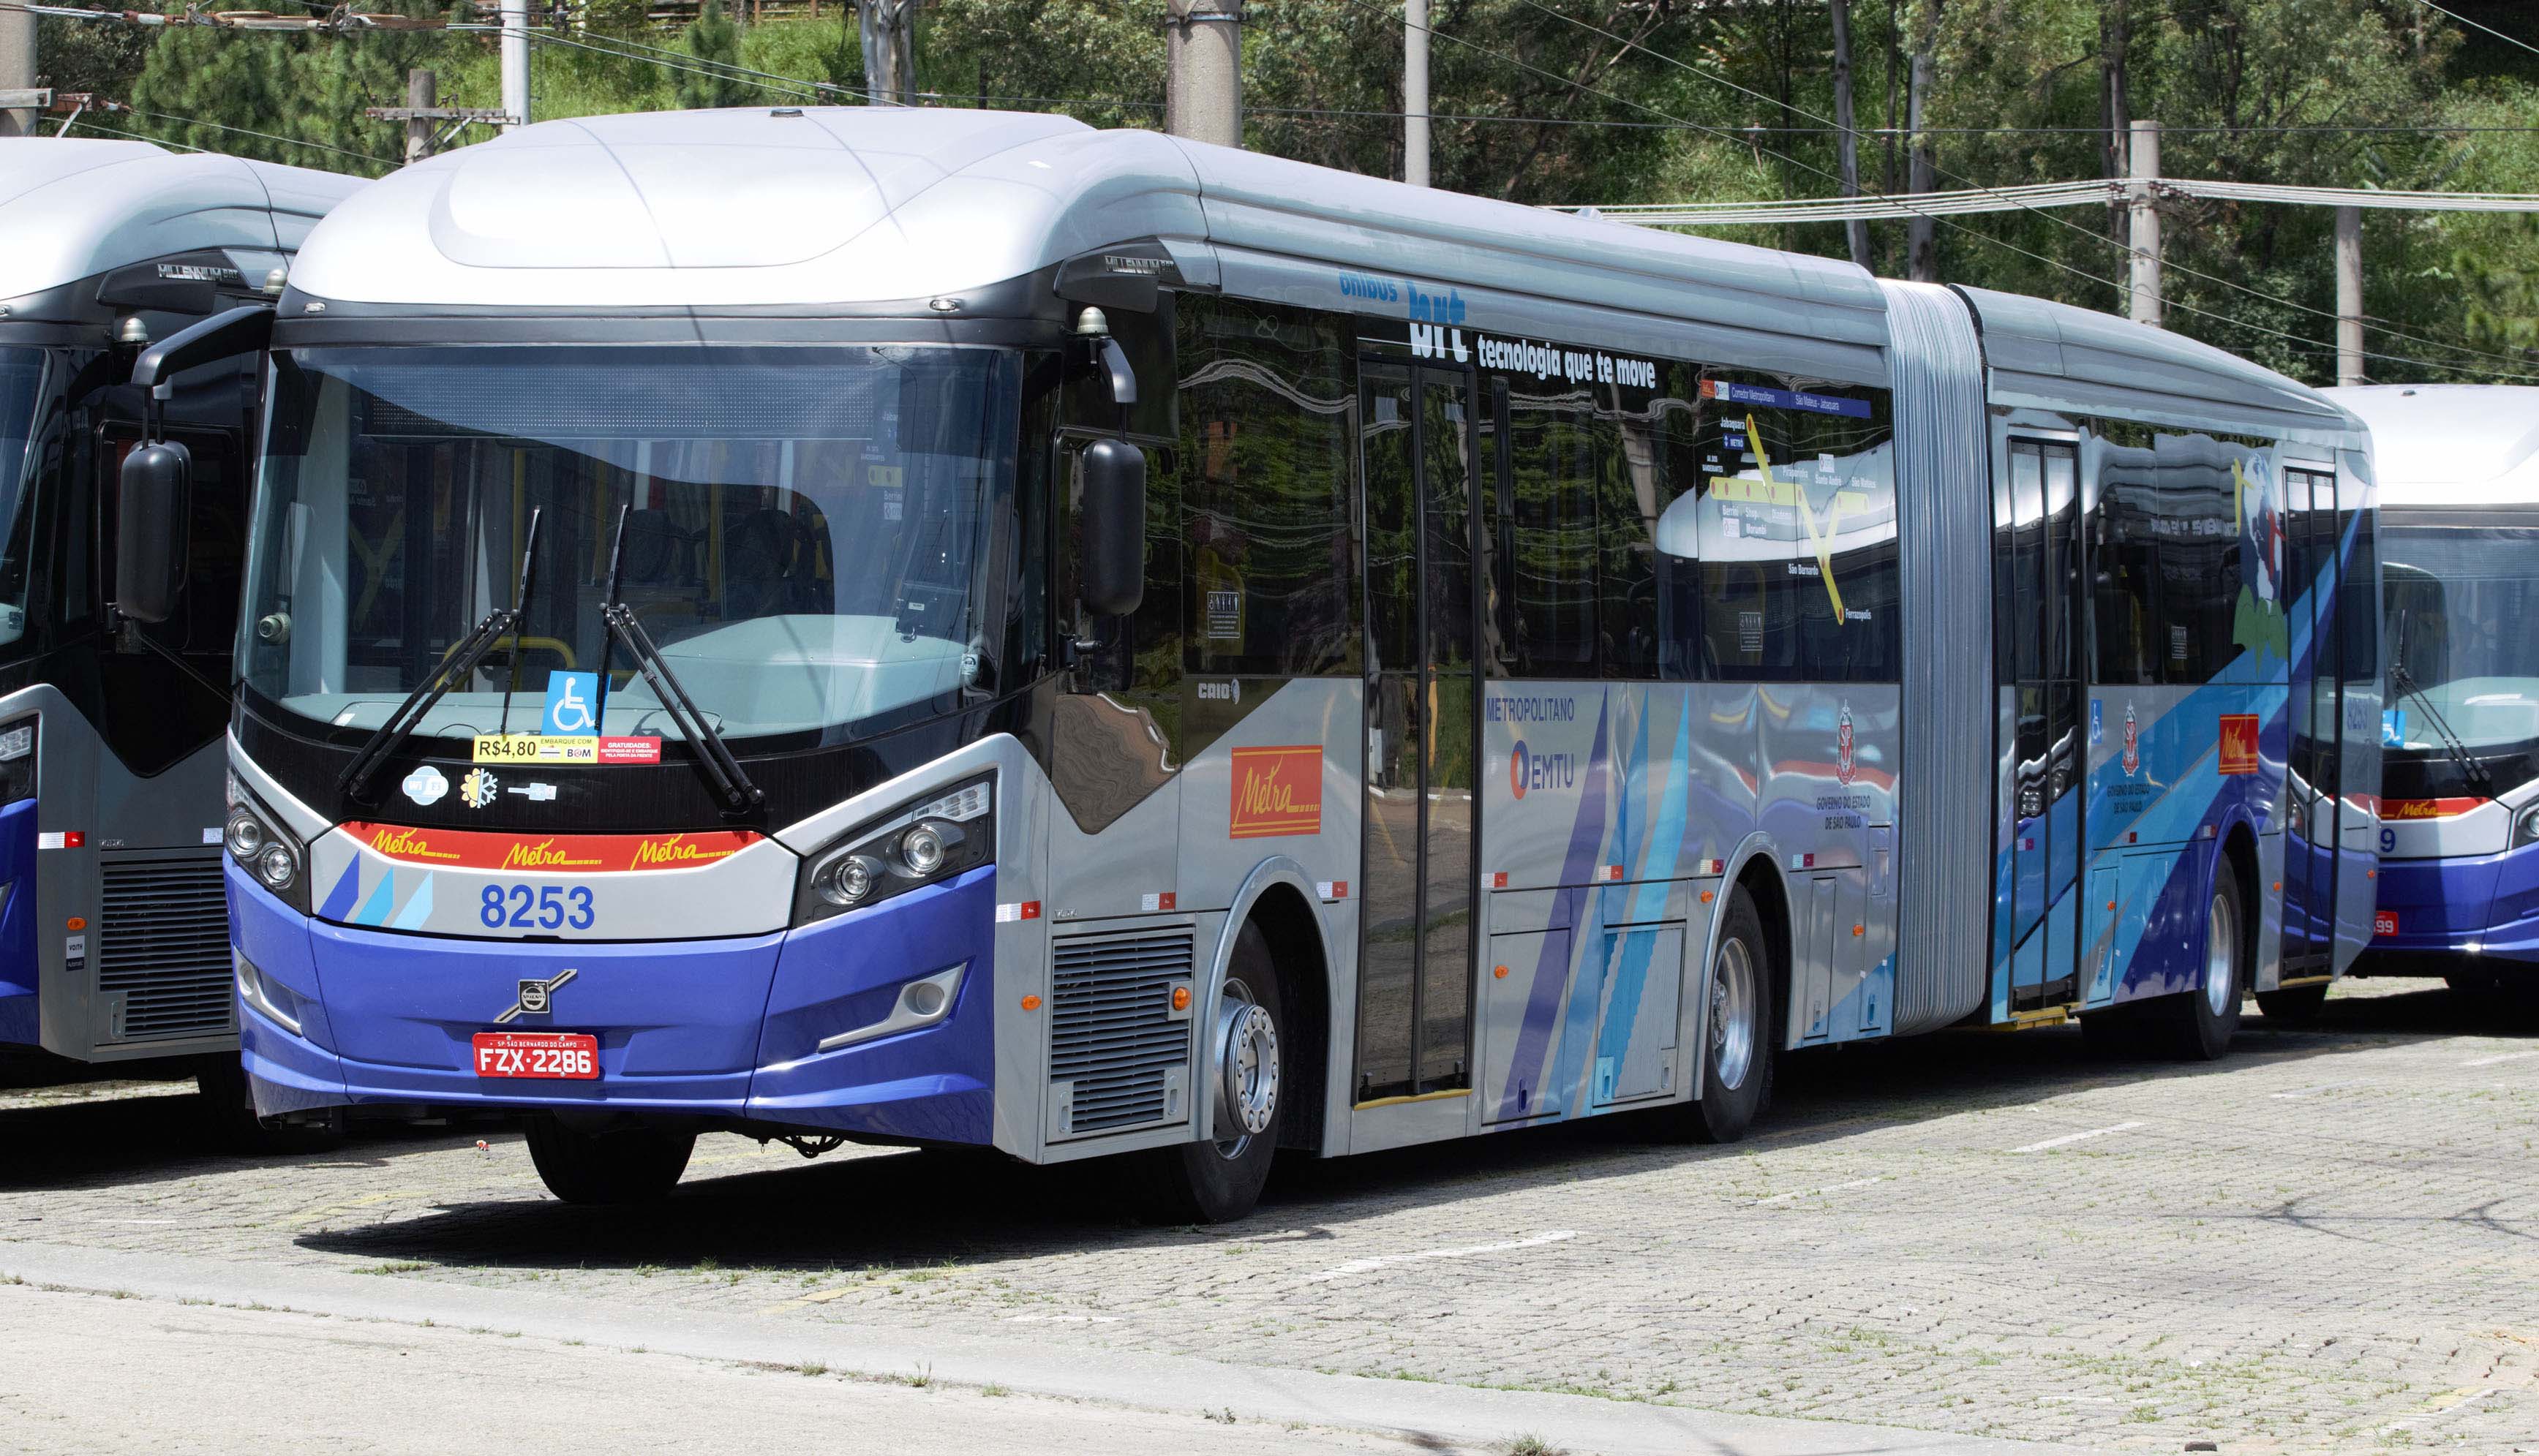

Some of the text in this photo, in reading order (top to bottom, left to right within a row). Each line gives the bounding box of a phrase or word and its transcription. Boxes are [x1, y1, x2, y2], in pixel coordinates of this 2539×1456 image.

[157, 263, 222, 282] MILLENNIUM
[1478, 334, 1655, 389] tecnologia que te move
[1720, 417, 1745, 431] Jabaquara
[1788, 563, 1818, 576] São Bernardo
[1198, 682, 1230, 699] CAIO
[1486, 698, 1574, 722] METROPOLITANO
[479, 740, 536, 758] R$4,80
[2220, 721, 2250, 766] Metra
[1532, 752, 1574, 790] EMTU
[1233, 755, 1301, 829] Metra
[1816, 795, 1870, 810] GOVERNO DO ESTADO
[2396, 799, 2447, 819] Metra
[1825, 812, 1862, 831] DE SÃO PAULO
[369, 828, 439, 858] Metra
[501, 838, 578, 870] Metra
[630, 833, 708, 872] Metra
[481, 883, 595, 930] 8253
